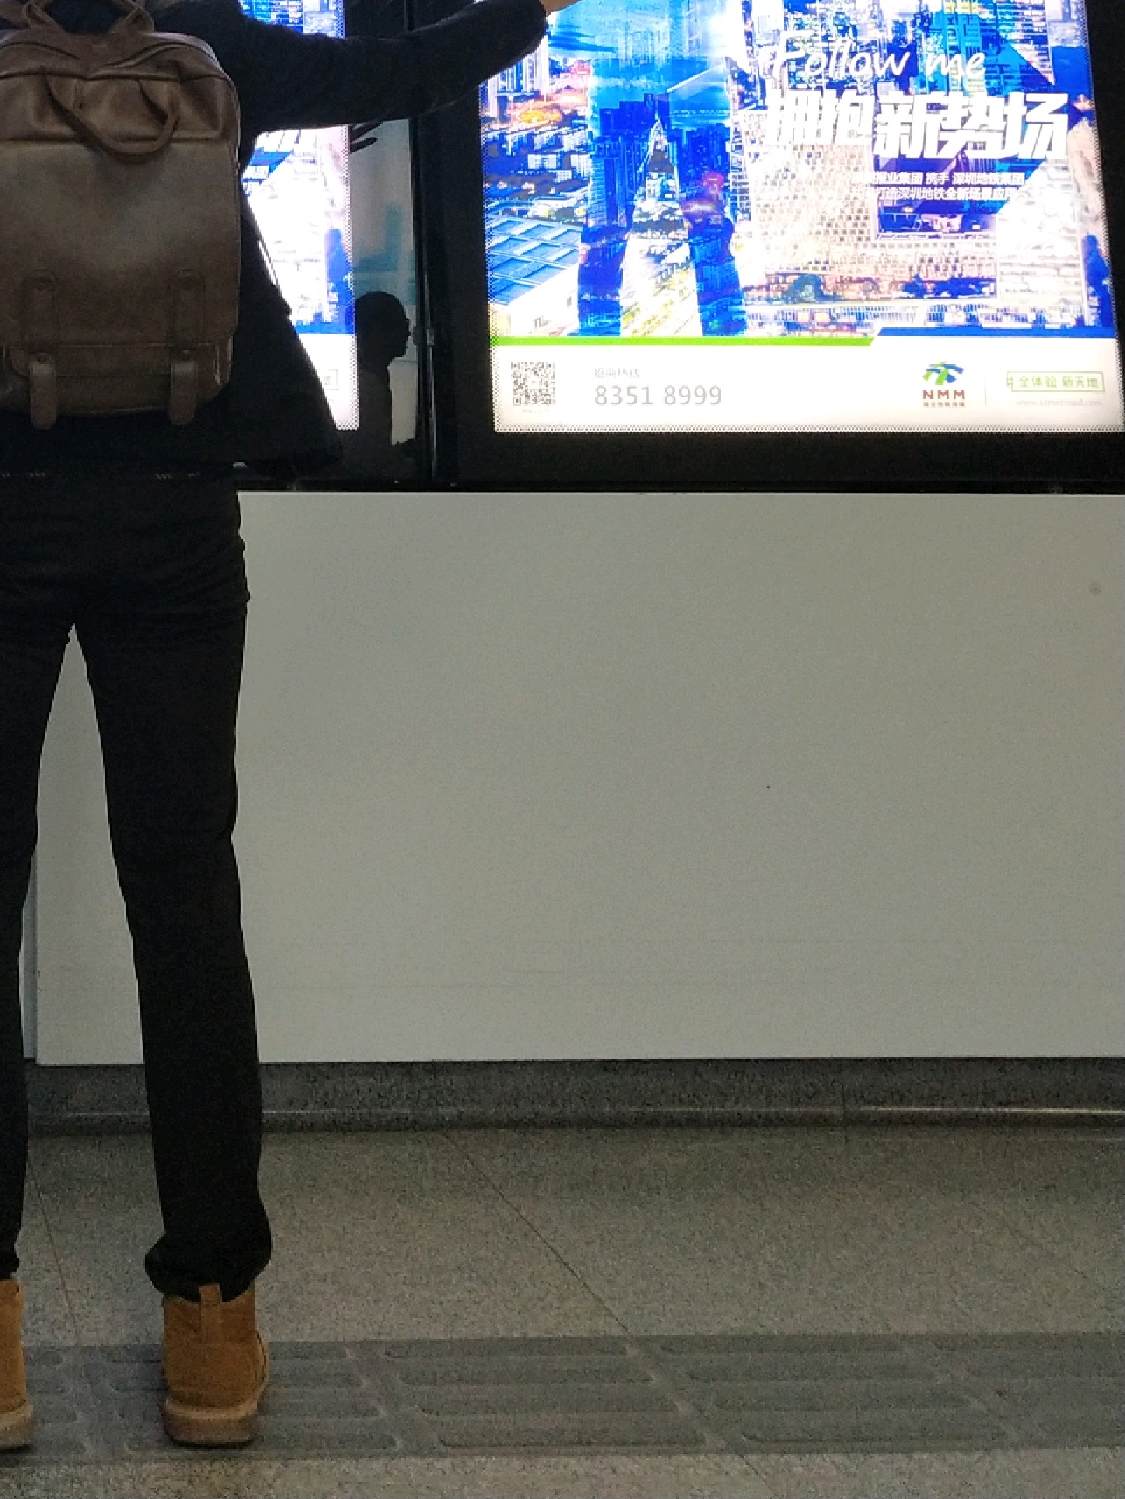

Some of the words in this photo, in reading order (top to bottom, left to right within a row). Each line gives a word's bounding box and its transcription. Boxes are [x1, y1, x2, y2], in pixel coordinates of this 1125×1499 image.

[769, 30, 911, 79] Follow
[924, 51, 986, 79] me
[594, 385, 654, 406] 8351
[664, 385, 722, 406] 8999
[922, 389, 966, 400] NMM
